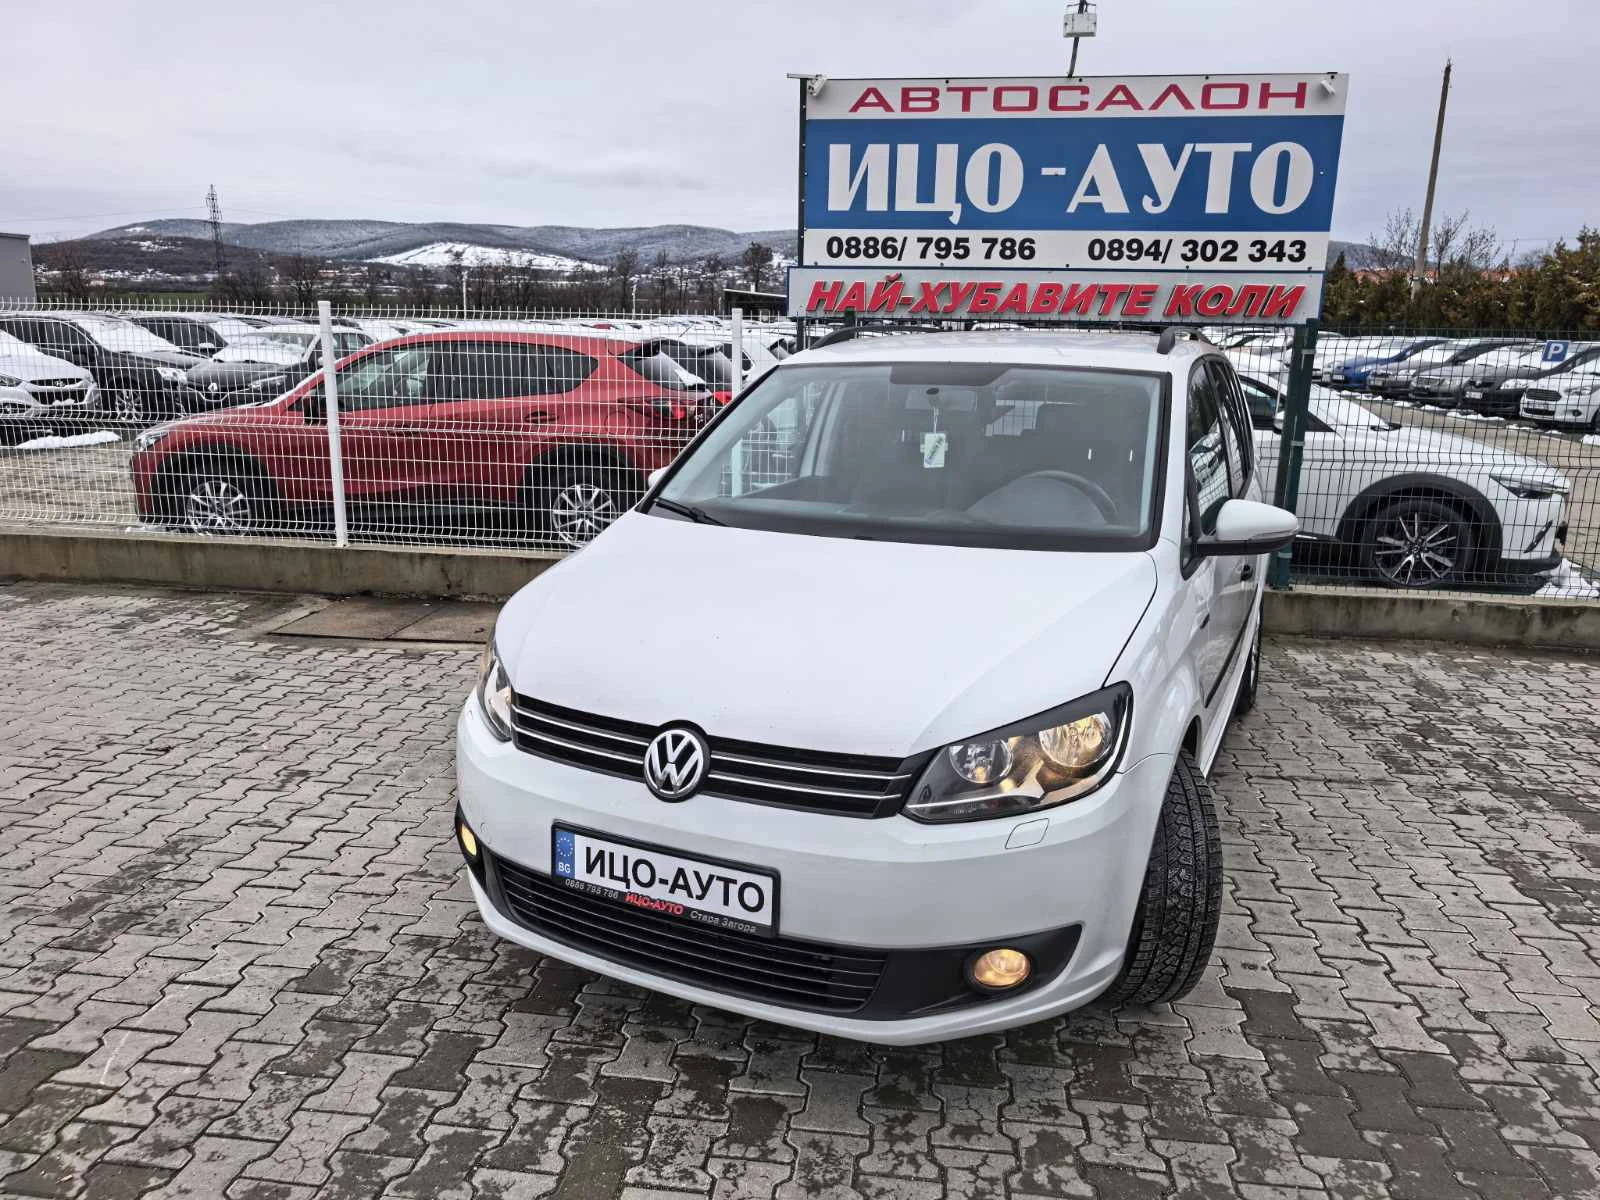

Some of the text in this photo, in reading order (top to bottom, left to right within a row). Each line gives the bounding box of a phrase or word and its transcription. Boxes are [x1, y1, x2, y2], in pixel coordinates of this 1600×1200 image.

[849, 82, 1307, 113] АВТОСАЛОН
[826, 235, 1036, 262] 0886/ 795 786
[1087, 238, 1306, 264] 0894/ 302 343
[805, 271, 1306, 319] НАЙ-ХУБАВИТЕ КОЛИ
[558, 861, 571, 874] BG
[585, 846, 765, 914] ИЦО-АУТО
[625, 892, 685, 915] ИЦО-АУТО
[690, 910, 719, 925] Стара
[721, 916, 756, 934] Загора
